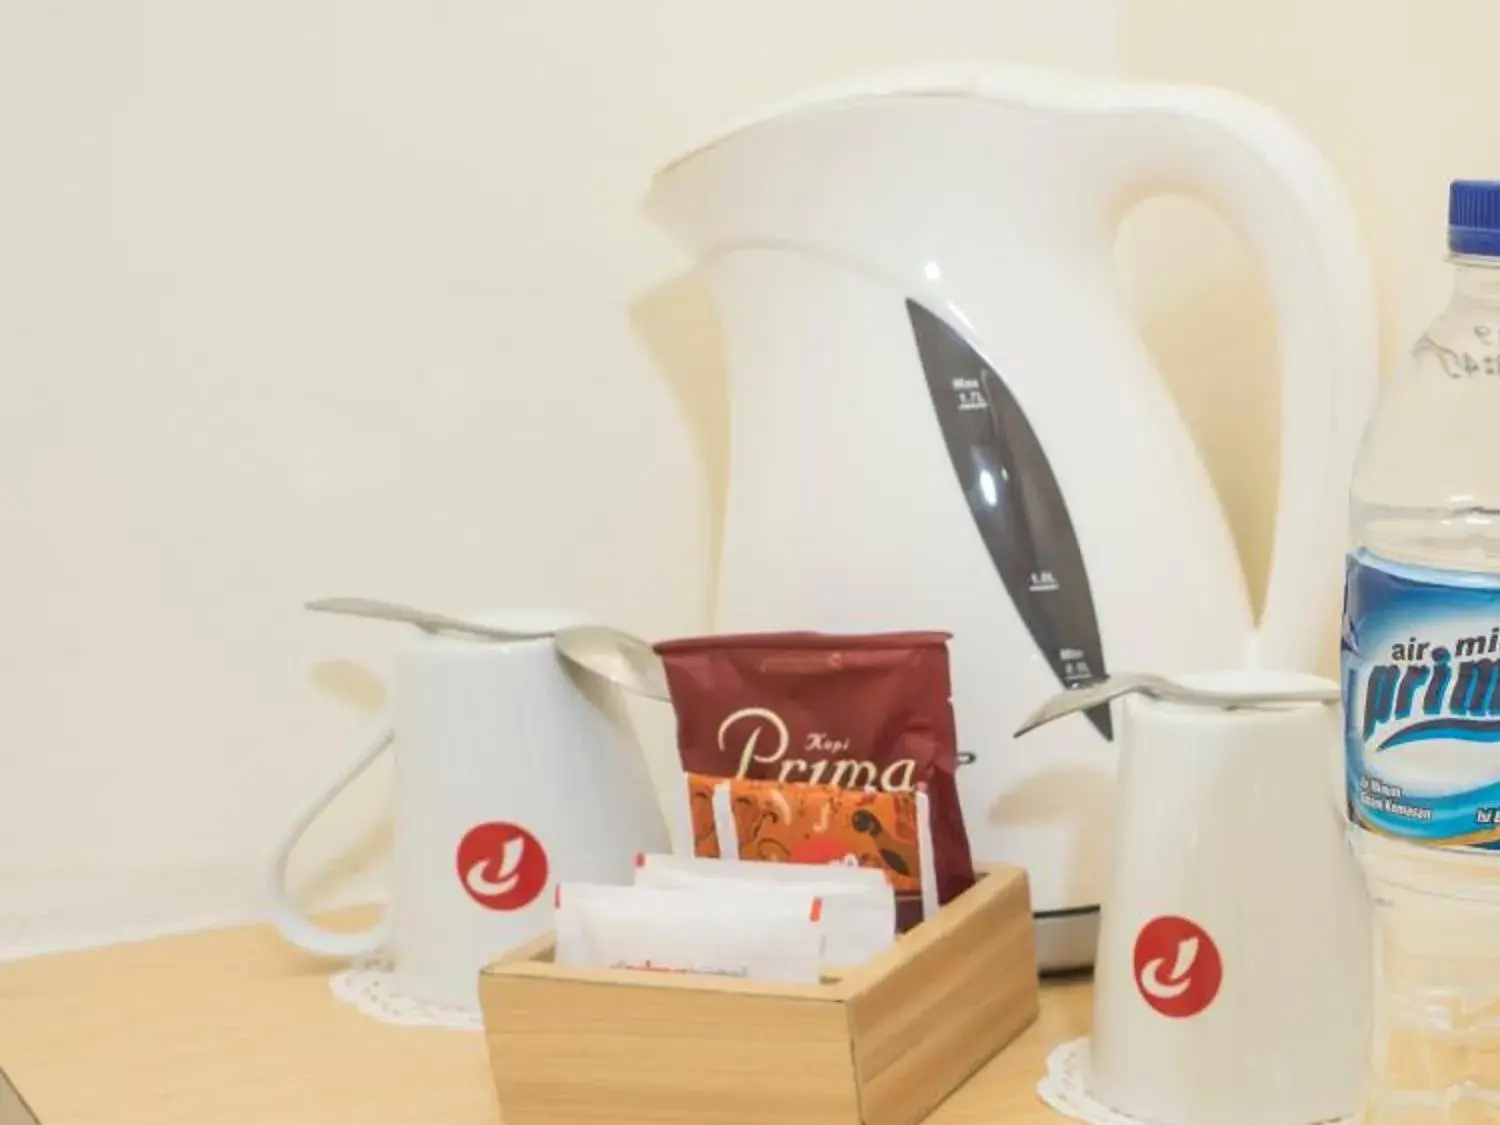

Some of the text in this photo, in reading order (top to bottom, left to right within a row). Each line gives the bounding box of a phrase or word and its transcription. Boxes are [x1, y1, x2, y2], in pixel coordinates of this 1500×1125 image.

[1391, 637, 1430, 662] air
[717, 706, 918, 794] Prima
[804, 731, 851, 752] Kopi
